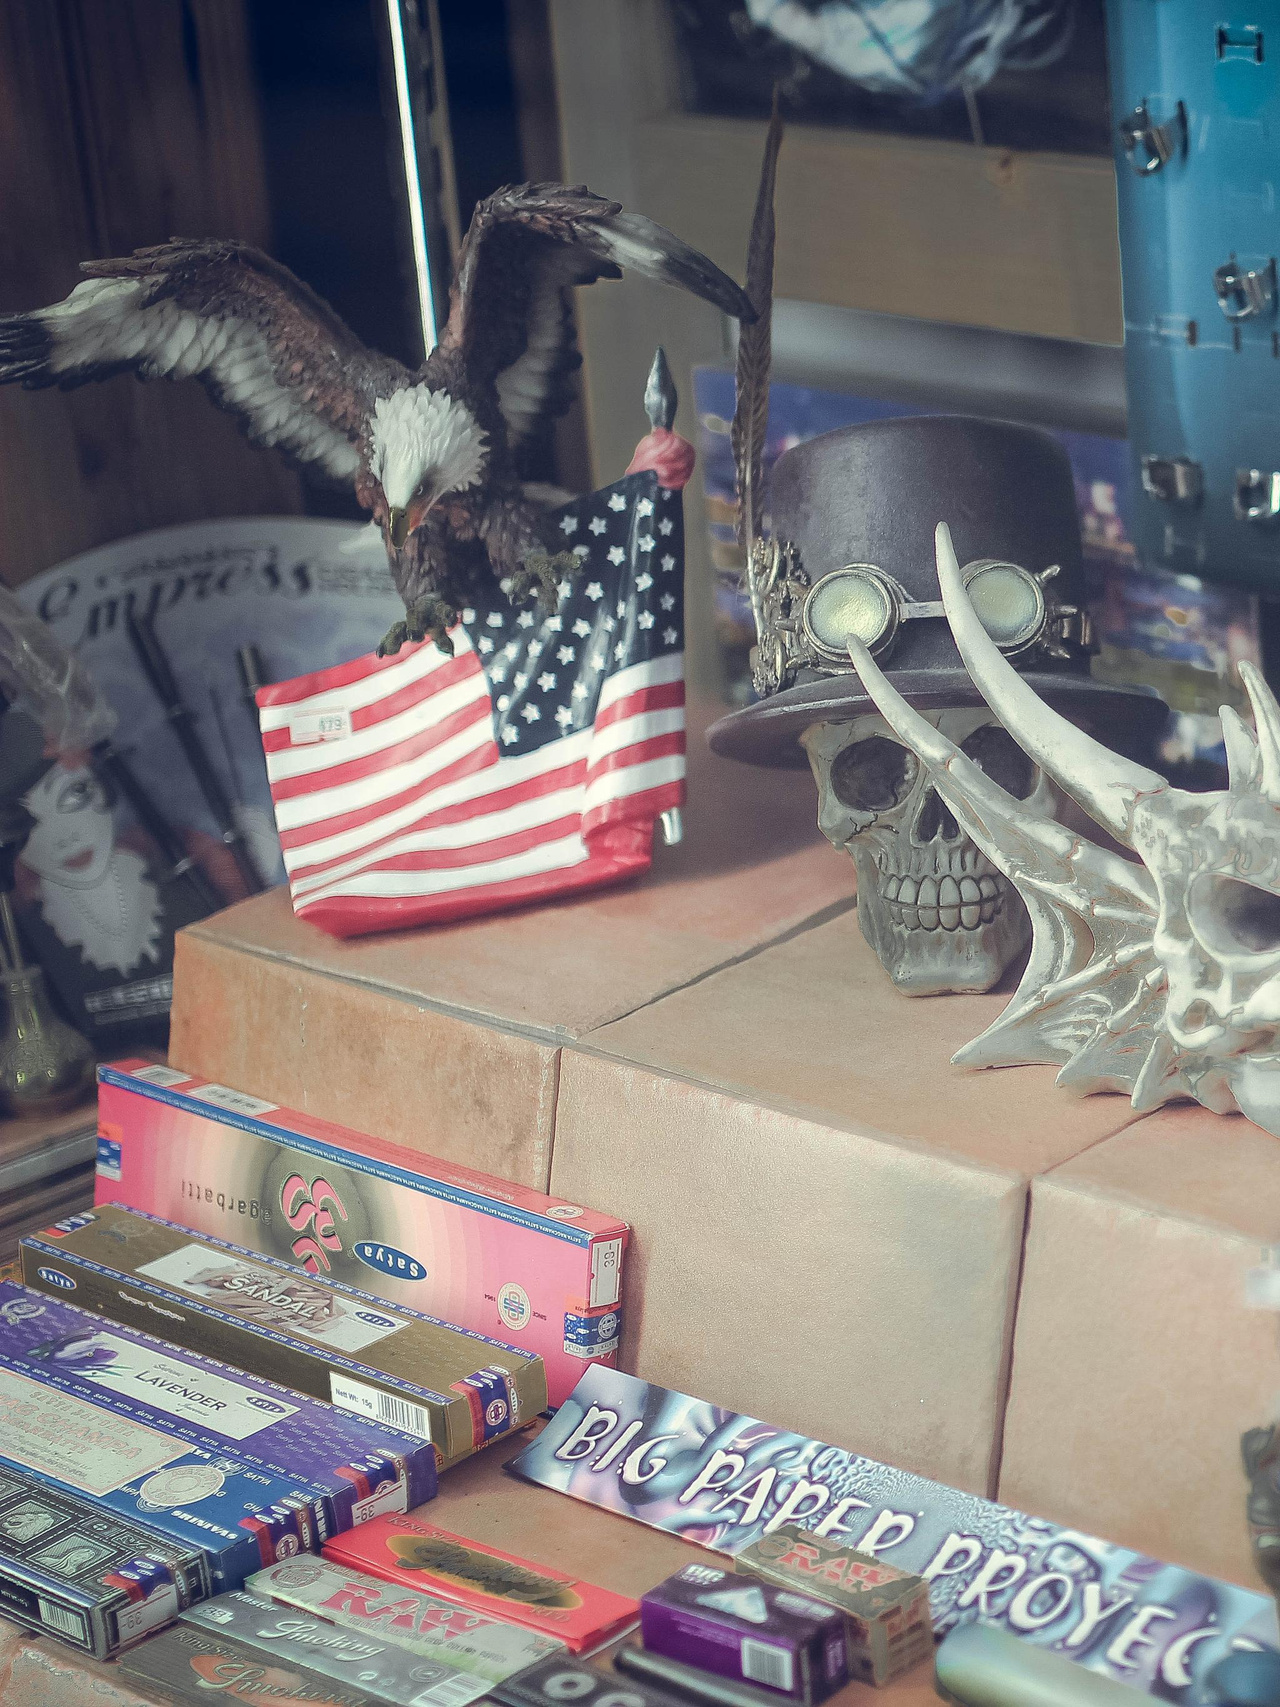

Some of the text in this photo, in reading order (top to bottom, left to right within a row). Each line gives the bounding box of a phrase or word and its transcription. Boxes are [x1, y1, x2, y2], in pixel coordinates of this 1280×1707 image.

[181, 1179, 273, 1226] agarbatti
[40, 1269, 72, 1288] Satya
[363, 1245, 420, 1278] Satya
[223, 1276, 318, 1319] SANDAL
[355, 1289, 373, 1300] SATYA
[377, 1297, 394, 1308] SATYA
[399, 1305, 417, 1316] SATYA
[422, 1313, 440, 1325] SATYA
[443, 1321, 462, 1332] SATYA
[466, 1329, 484, 1341] SATYA
[488, 1338, 507, 1349] SATYA
[511, 1346, 530, 1357] SATYA
[358, 1311, 391, 1327] Satya
[226, 1315, 245, 1326] SATYA
[248, 1323, 266, 1334] SATYA
[269, 1331, 288, 1343] SATYA
[290, 1339, 309, 1351] SATYA
[312, 1348, 331, 1359] SATYA
[334, 1356, 354, 1368] SATYA
[357, 1365, 376, 1376] SATYA
[380, 1373, 398, 1385] SATYA
[402, 1382, 422, 1394] SATYA
[426, 1391, 445, 1403] SATYA
[134, 1370, 228, 1412] LAVENDER
[226, 1365, 244, 1377] SATYA
[247, 1373, 266, 1385] SATYA
[268, 1382, 288, 1393] SATYA
[290, 1390, 309, 1402] SATYA
[312, 1398, 330, 1410] SATYA
[334, 1407, 353, 1418] SATYA
[356, 1415, 376, 1427] SATYA
[378, 1424, 398, 1436] SATYA
[402, 1432, 422, 1445] SATYA
[249, 1397, 281, 1413] Satya
[335, 1388, 373, 1410] Nett Wt: 15g
[156, 1417, 176, 1429] SATYA
[178, 1426, 198, 1438] SATYA
[200, 1435, 219, 1447] SATYA
[222, 1444, 241, 1456] SATYA
[244, 1453, 263, 1465] SATYA
[266, 1462, 286, 1475] SATYA
[288, 1472, 309, 1484] SATYA
[312, 1481, 332, 1494] SATYA
[243, 1471, 273, 1487] SATYA
[170, 1510, 239, 1540] SRINIVAS
[555, 1405, 680, 1485] BIG
[678, 1448, 915, 1557] PAPER
[920, 1531, 1264, 1687] PROYEC
[777, 1543, 898, 1593] RAW
[229, 1591, 278, 1613] Master
[318, 1581, 498, 1641] RAW
[256, 1621, 385, 1662] Smoking
